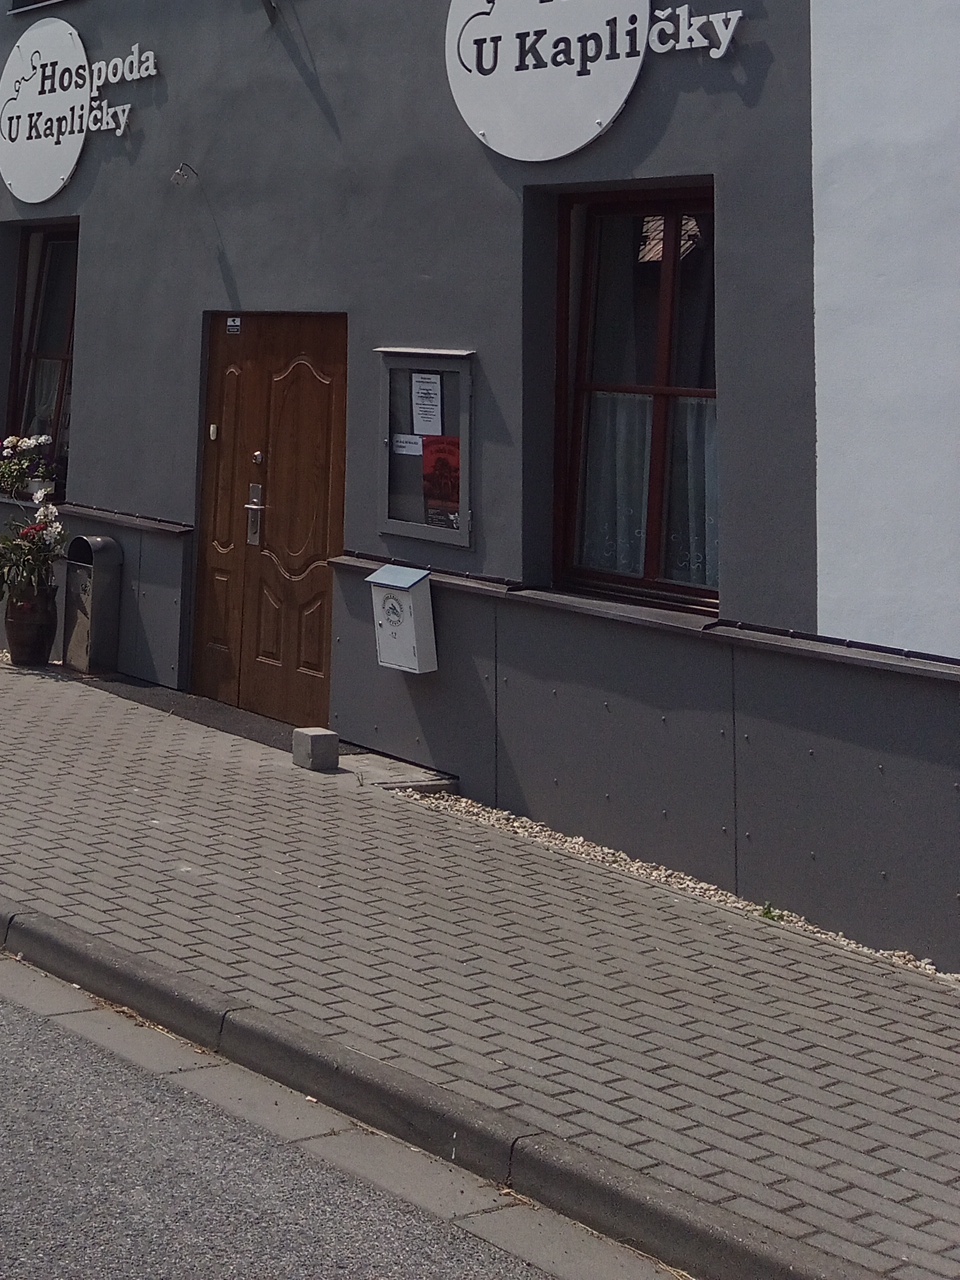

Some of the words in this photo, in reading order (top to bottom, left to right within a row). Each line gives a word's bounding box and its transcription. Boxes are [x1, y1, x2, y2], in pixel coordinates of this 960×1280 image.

[473, 35, 502, 76] U
[514, 4, 743, 77] Kapličky
[38, 42, 157, 98] Hospoda
[7, 115, 22, 144] U
[26, 99, 132, 146] Kapličky
